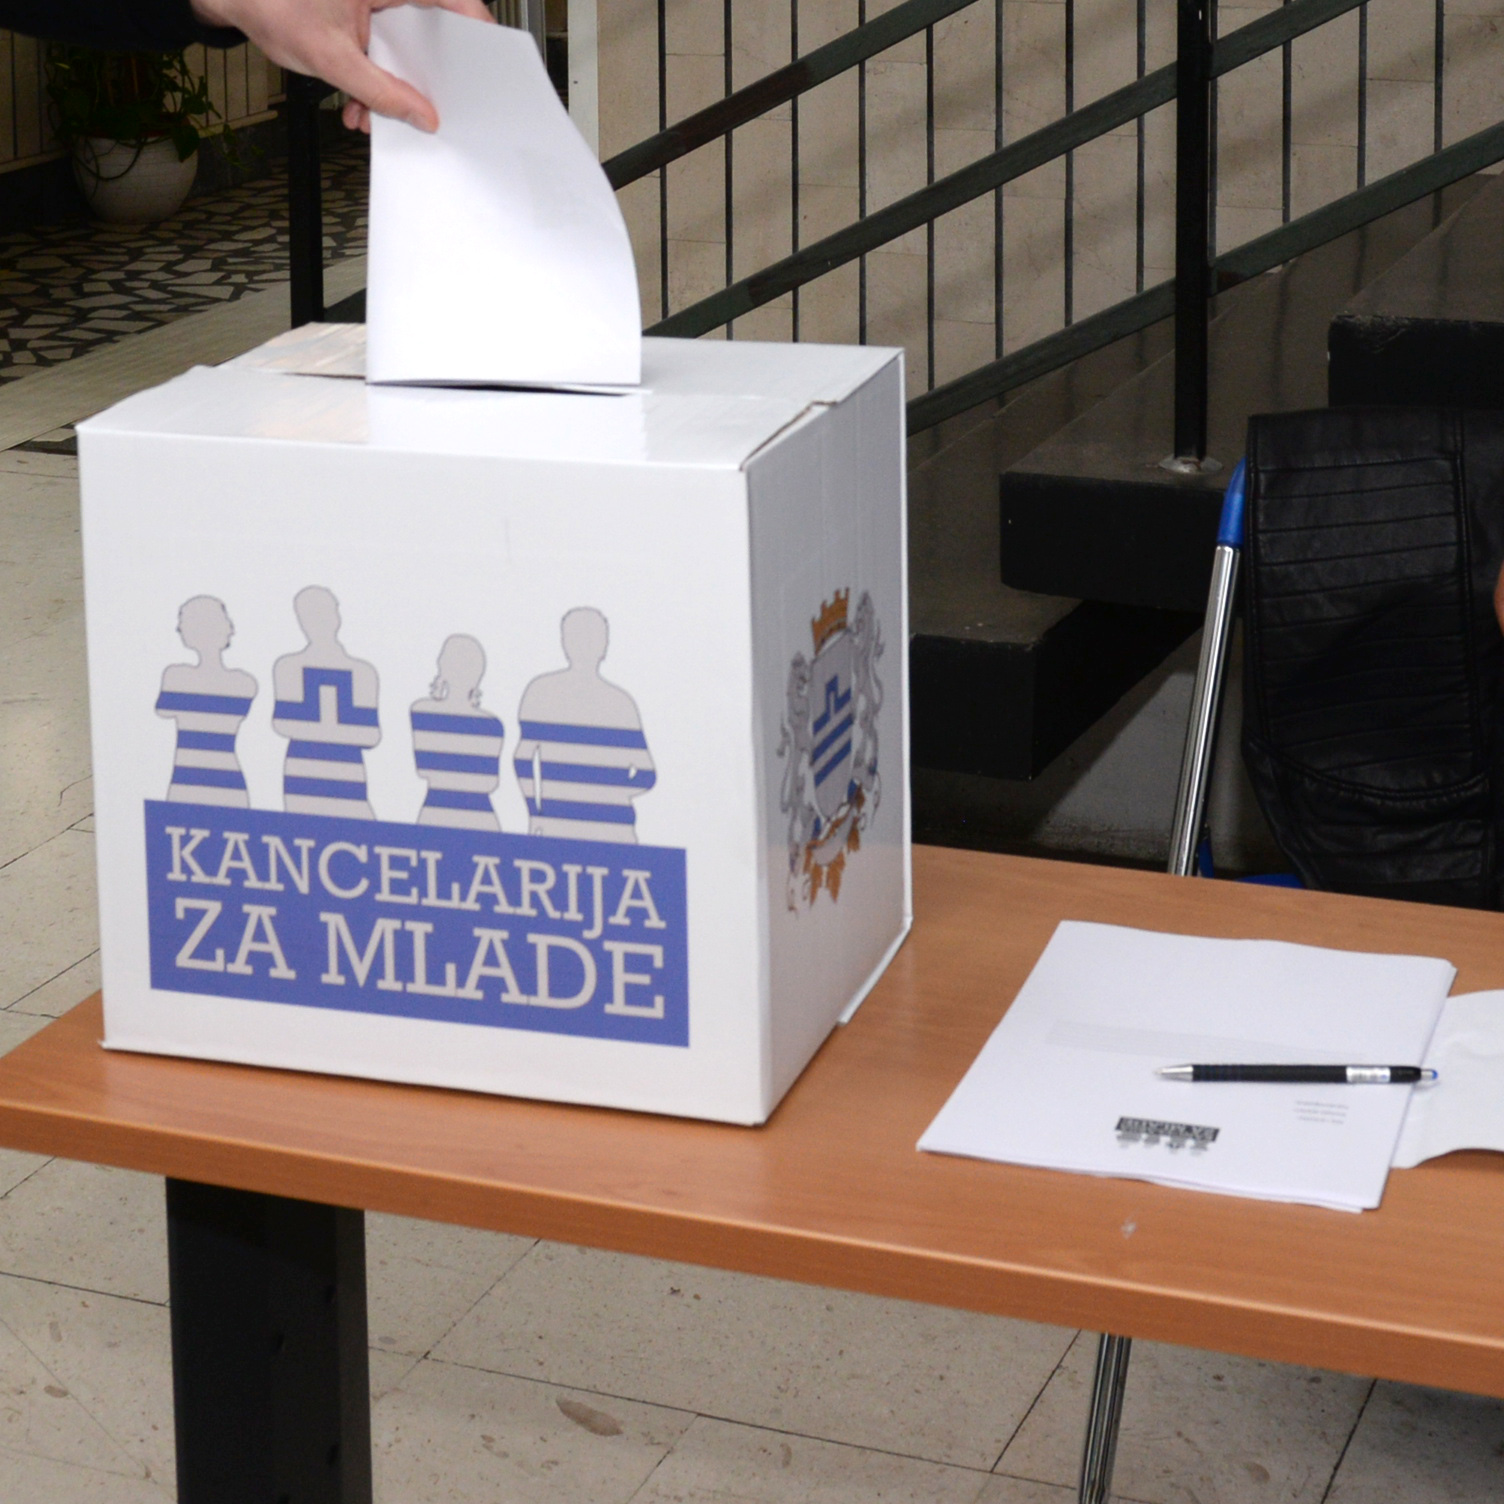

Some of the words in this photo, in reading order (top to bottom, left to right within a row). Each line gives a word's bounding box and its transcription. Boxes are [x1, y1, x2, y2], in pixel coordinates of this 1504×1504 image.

[164, 826, 666, 940] KANCELARIJA
[175, 896, 296, 981] ZA
[319, 911, 666, 1020] MLADE
